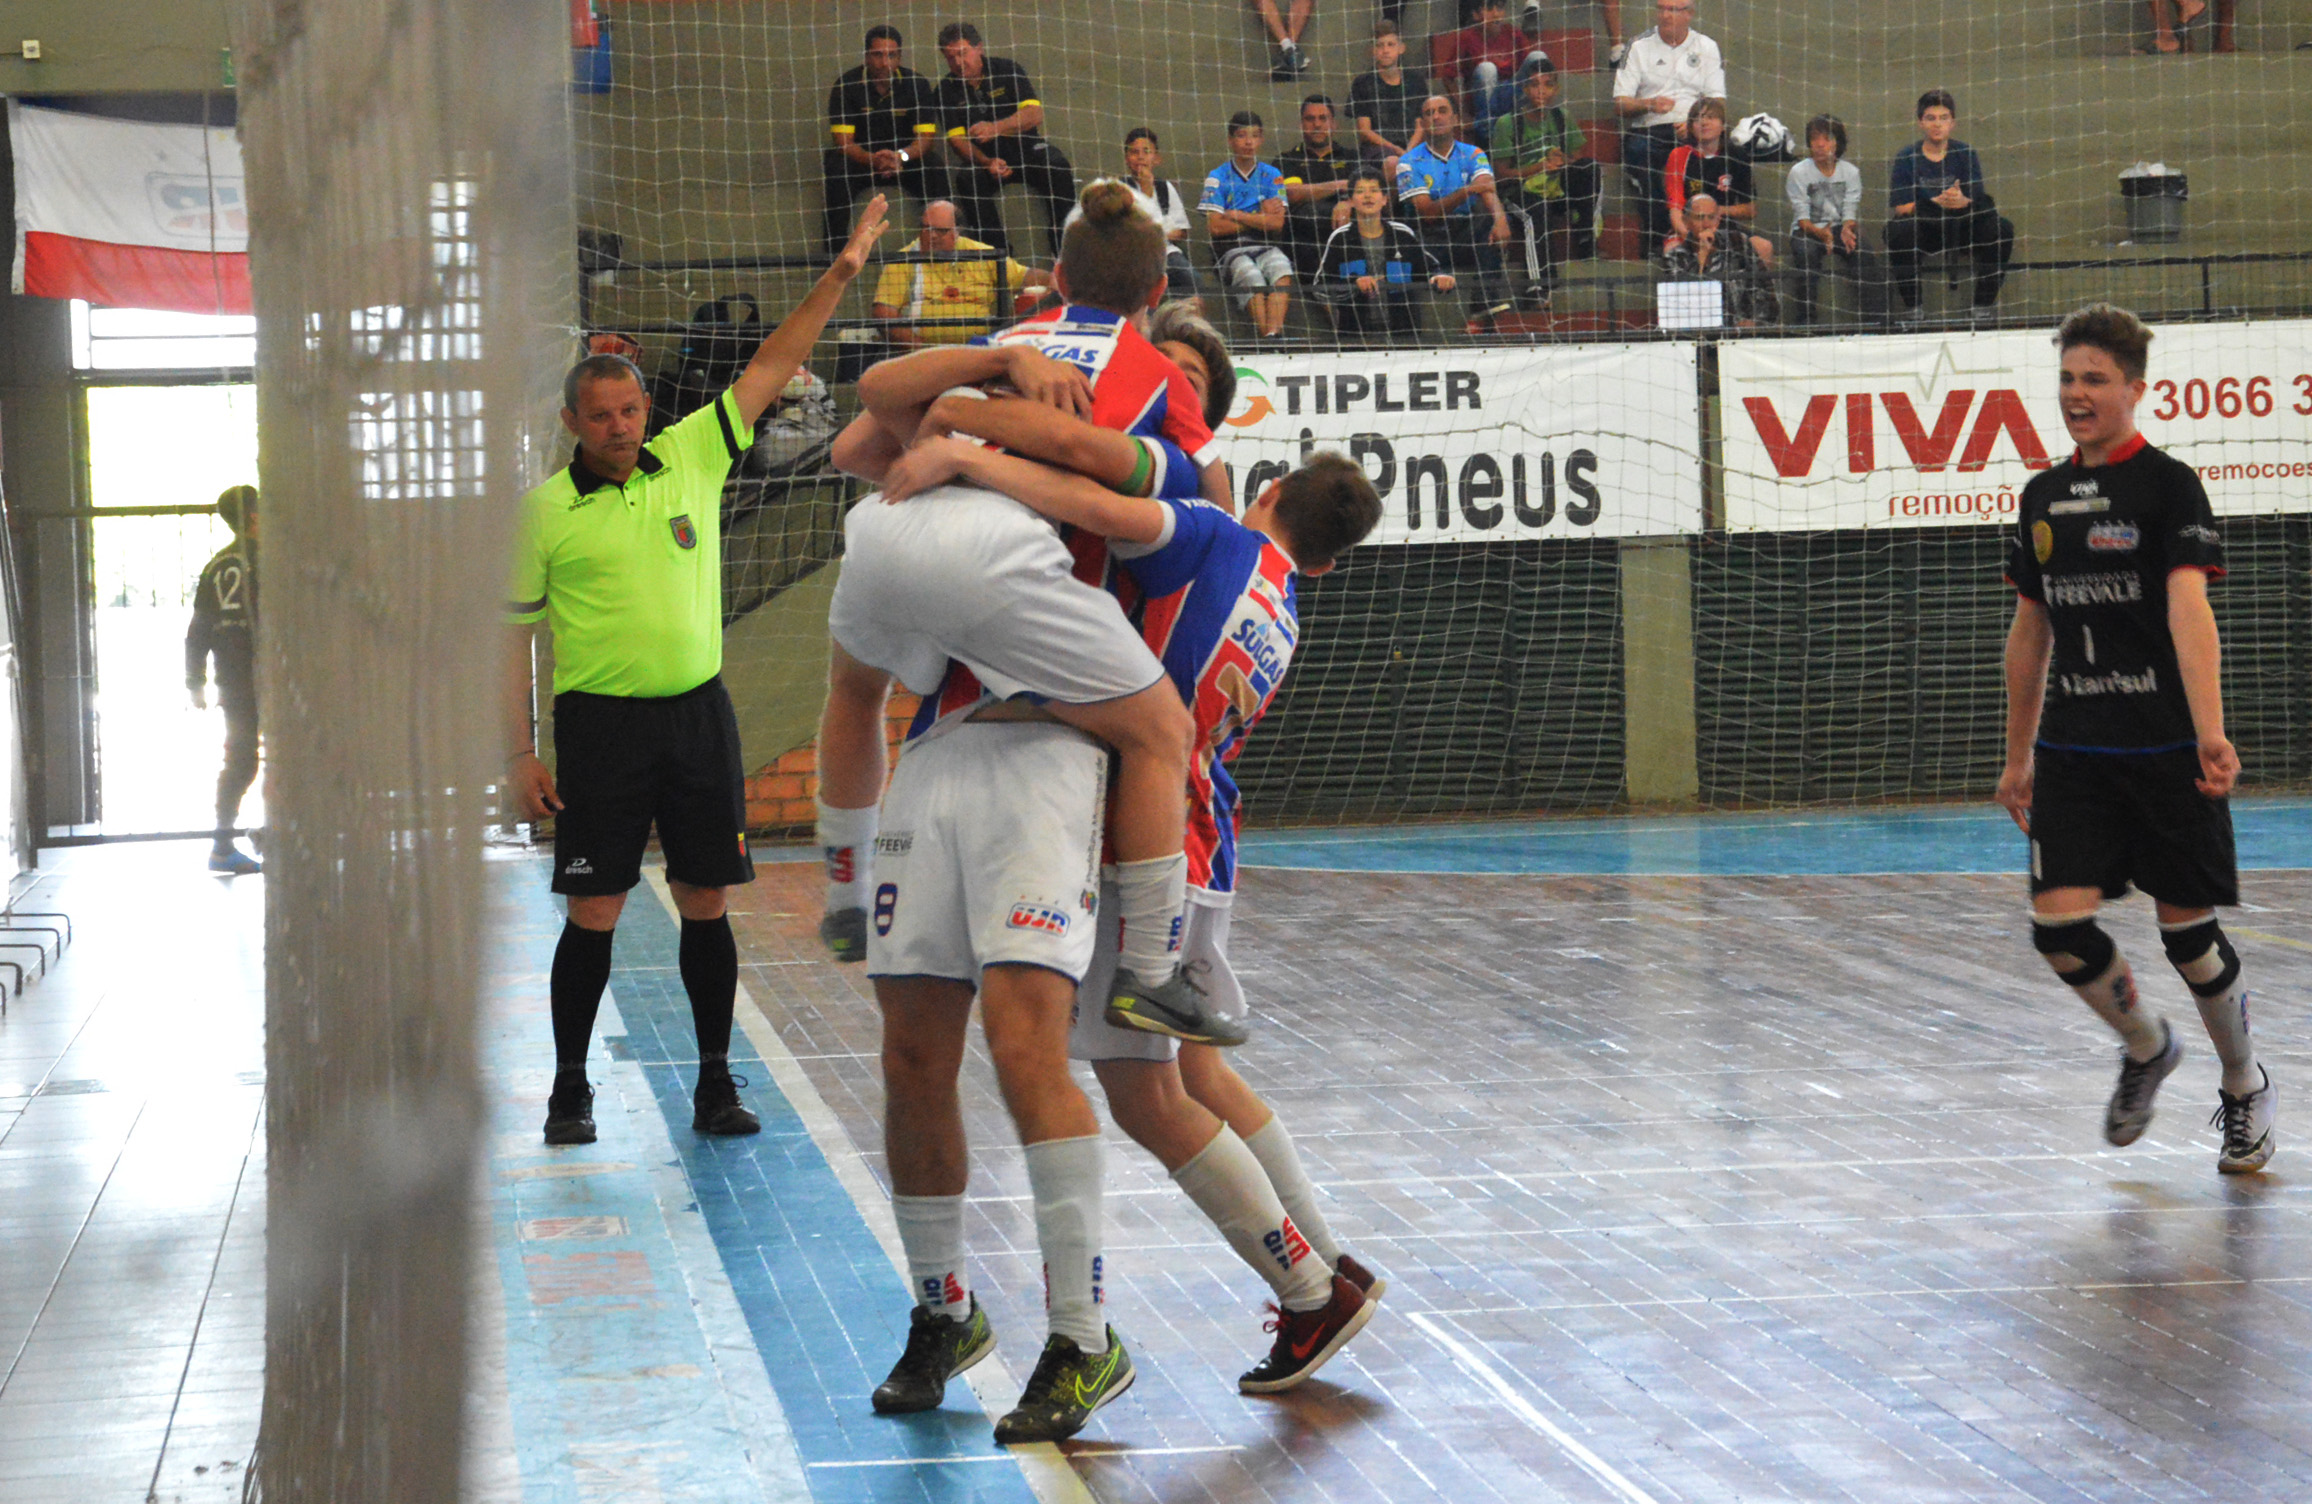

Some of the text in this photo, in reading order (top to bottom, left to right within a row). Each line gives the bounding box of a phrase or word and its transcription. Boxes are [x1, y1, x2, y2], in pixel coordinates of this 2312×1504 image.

[1041, 344, 1100, 363] GAS
[1276, 370, 1483, 416] TIPLER
[2153, 375, 2274, 422] 3066
[1741, 388, 2053, 478] VIVA
[1348, 432, 1602, 531] Pneus
[1888, 484, 2024, 521] remoçõ
[213, 565, 242, 610] 12
[2081, 623, 2096, 665] 1
